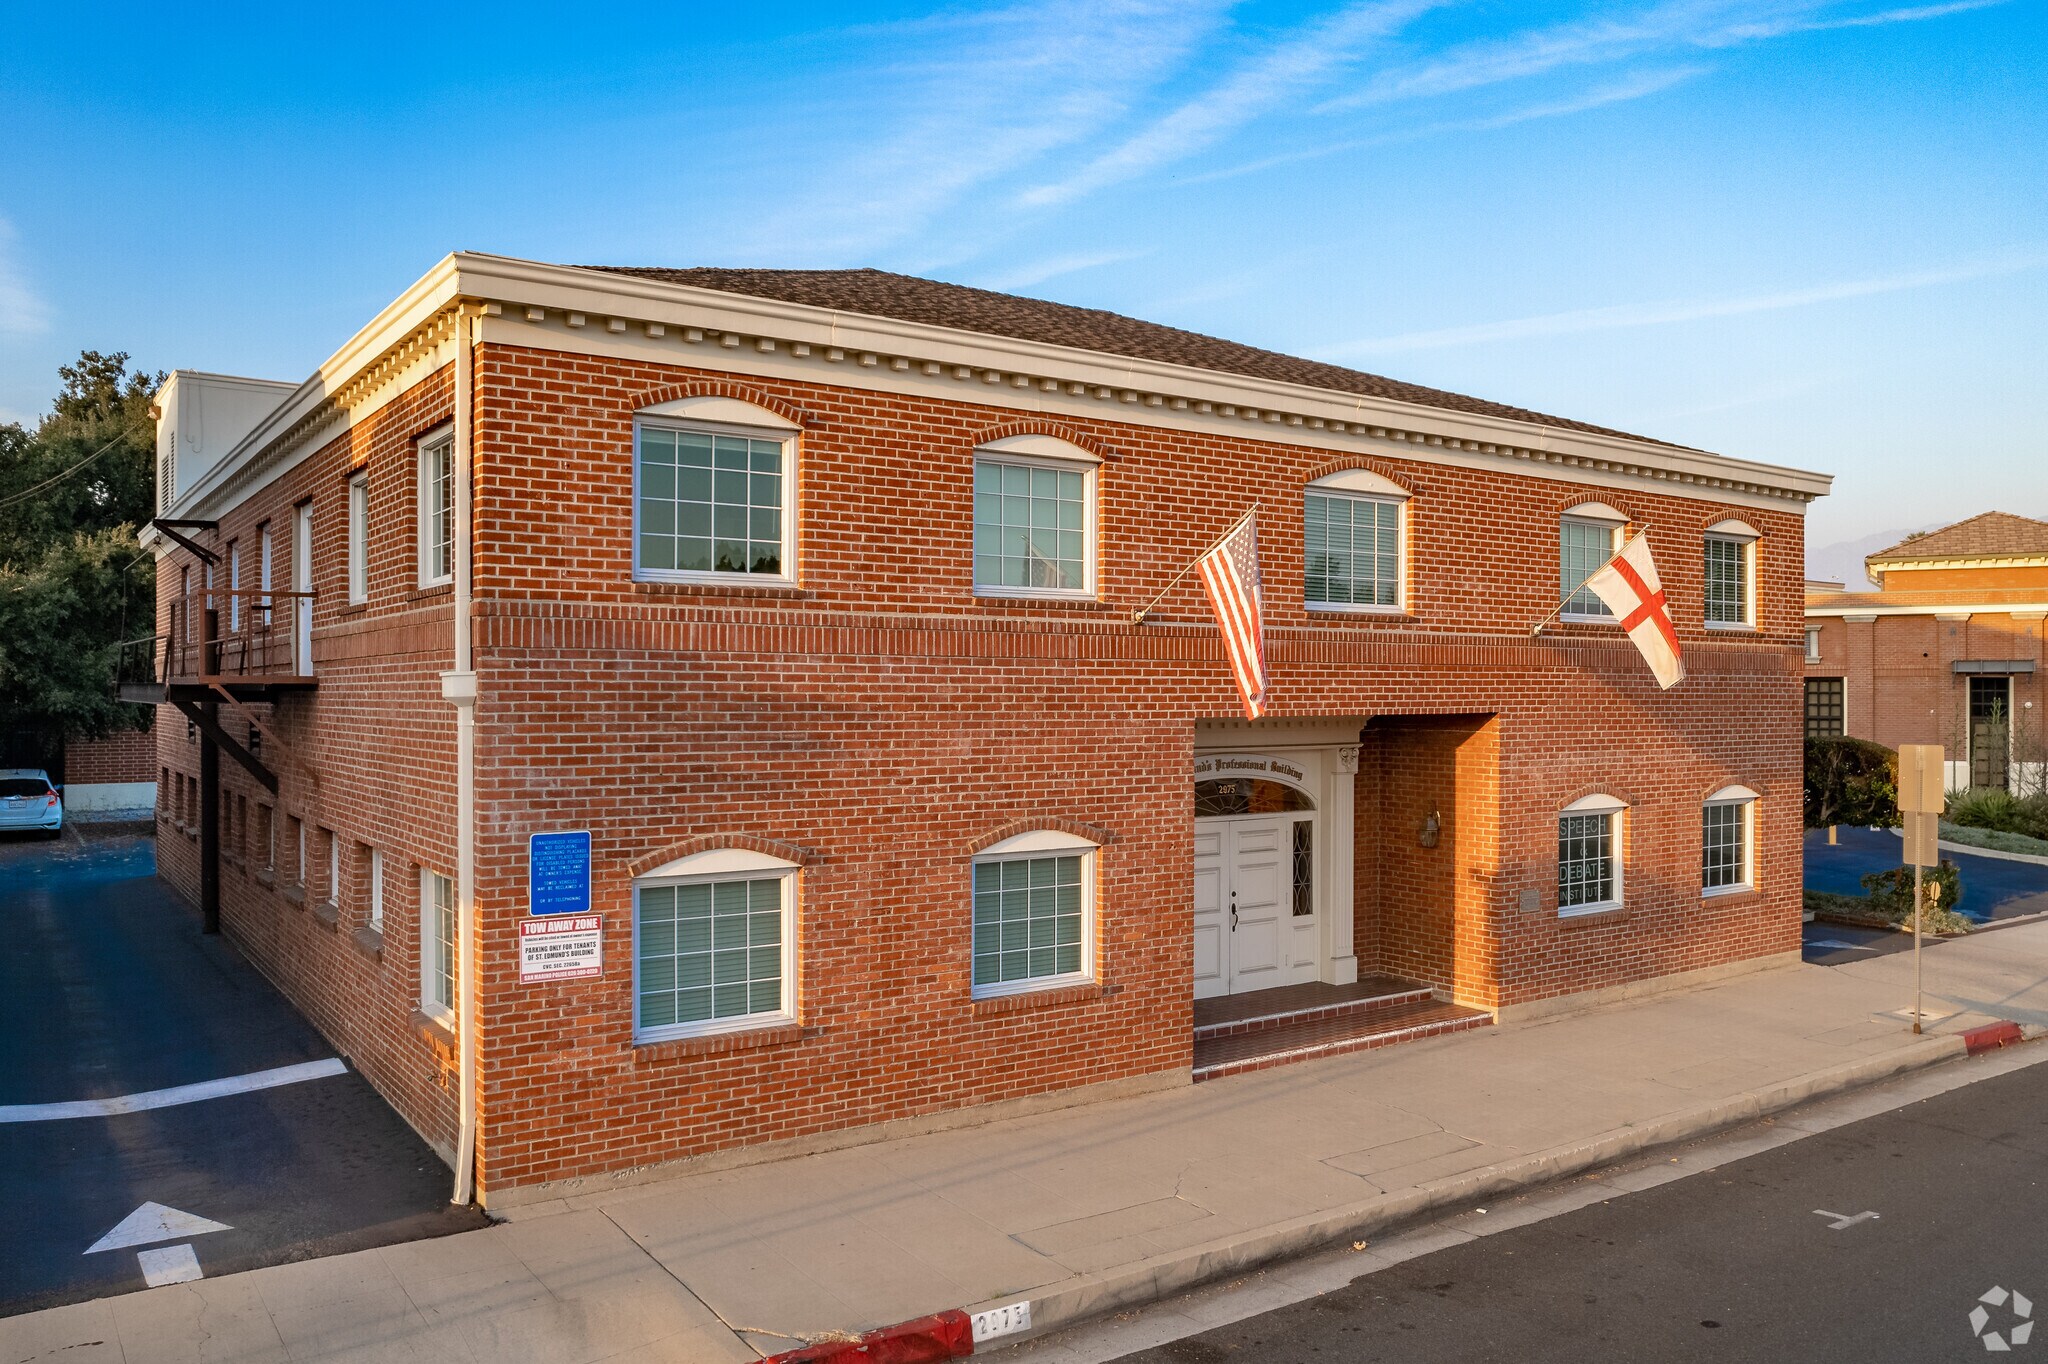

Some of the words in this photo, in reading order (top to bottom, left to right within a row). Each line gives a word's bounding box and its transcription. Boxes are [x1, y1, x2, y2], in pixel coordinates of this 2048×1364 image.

[1215, 759, 1266, 771] Professional
[1270, 761, 1303, 781] Building
[1560, 818, 1606, 836] SPEECH
[1560, 862, 1605, 881] DEBATE
[524, 922, 547, 934] TOW
[547, 920, 574, 933] AWAY
[575, 918, 598, 930] ZONE
[525, 946, 548, 954] PARKING
[544, 951, 570, 960] EDMUND'S
